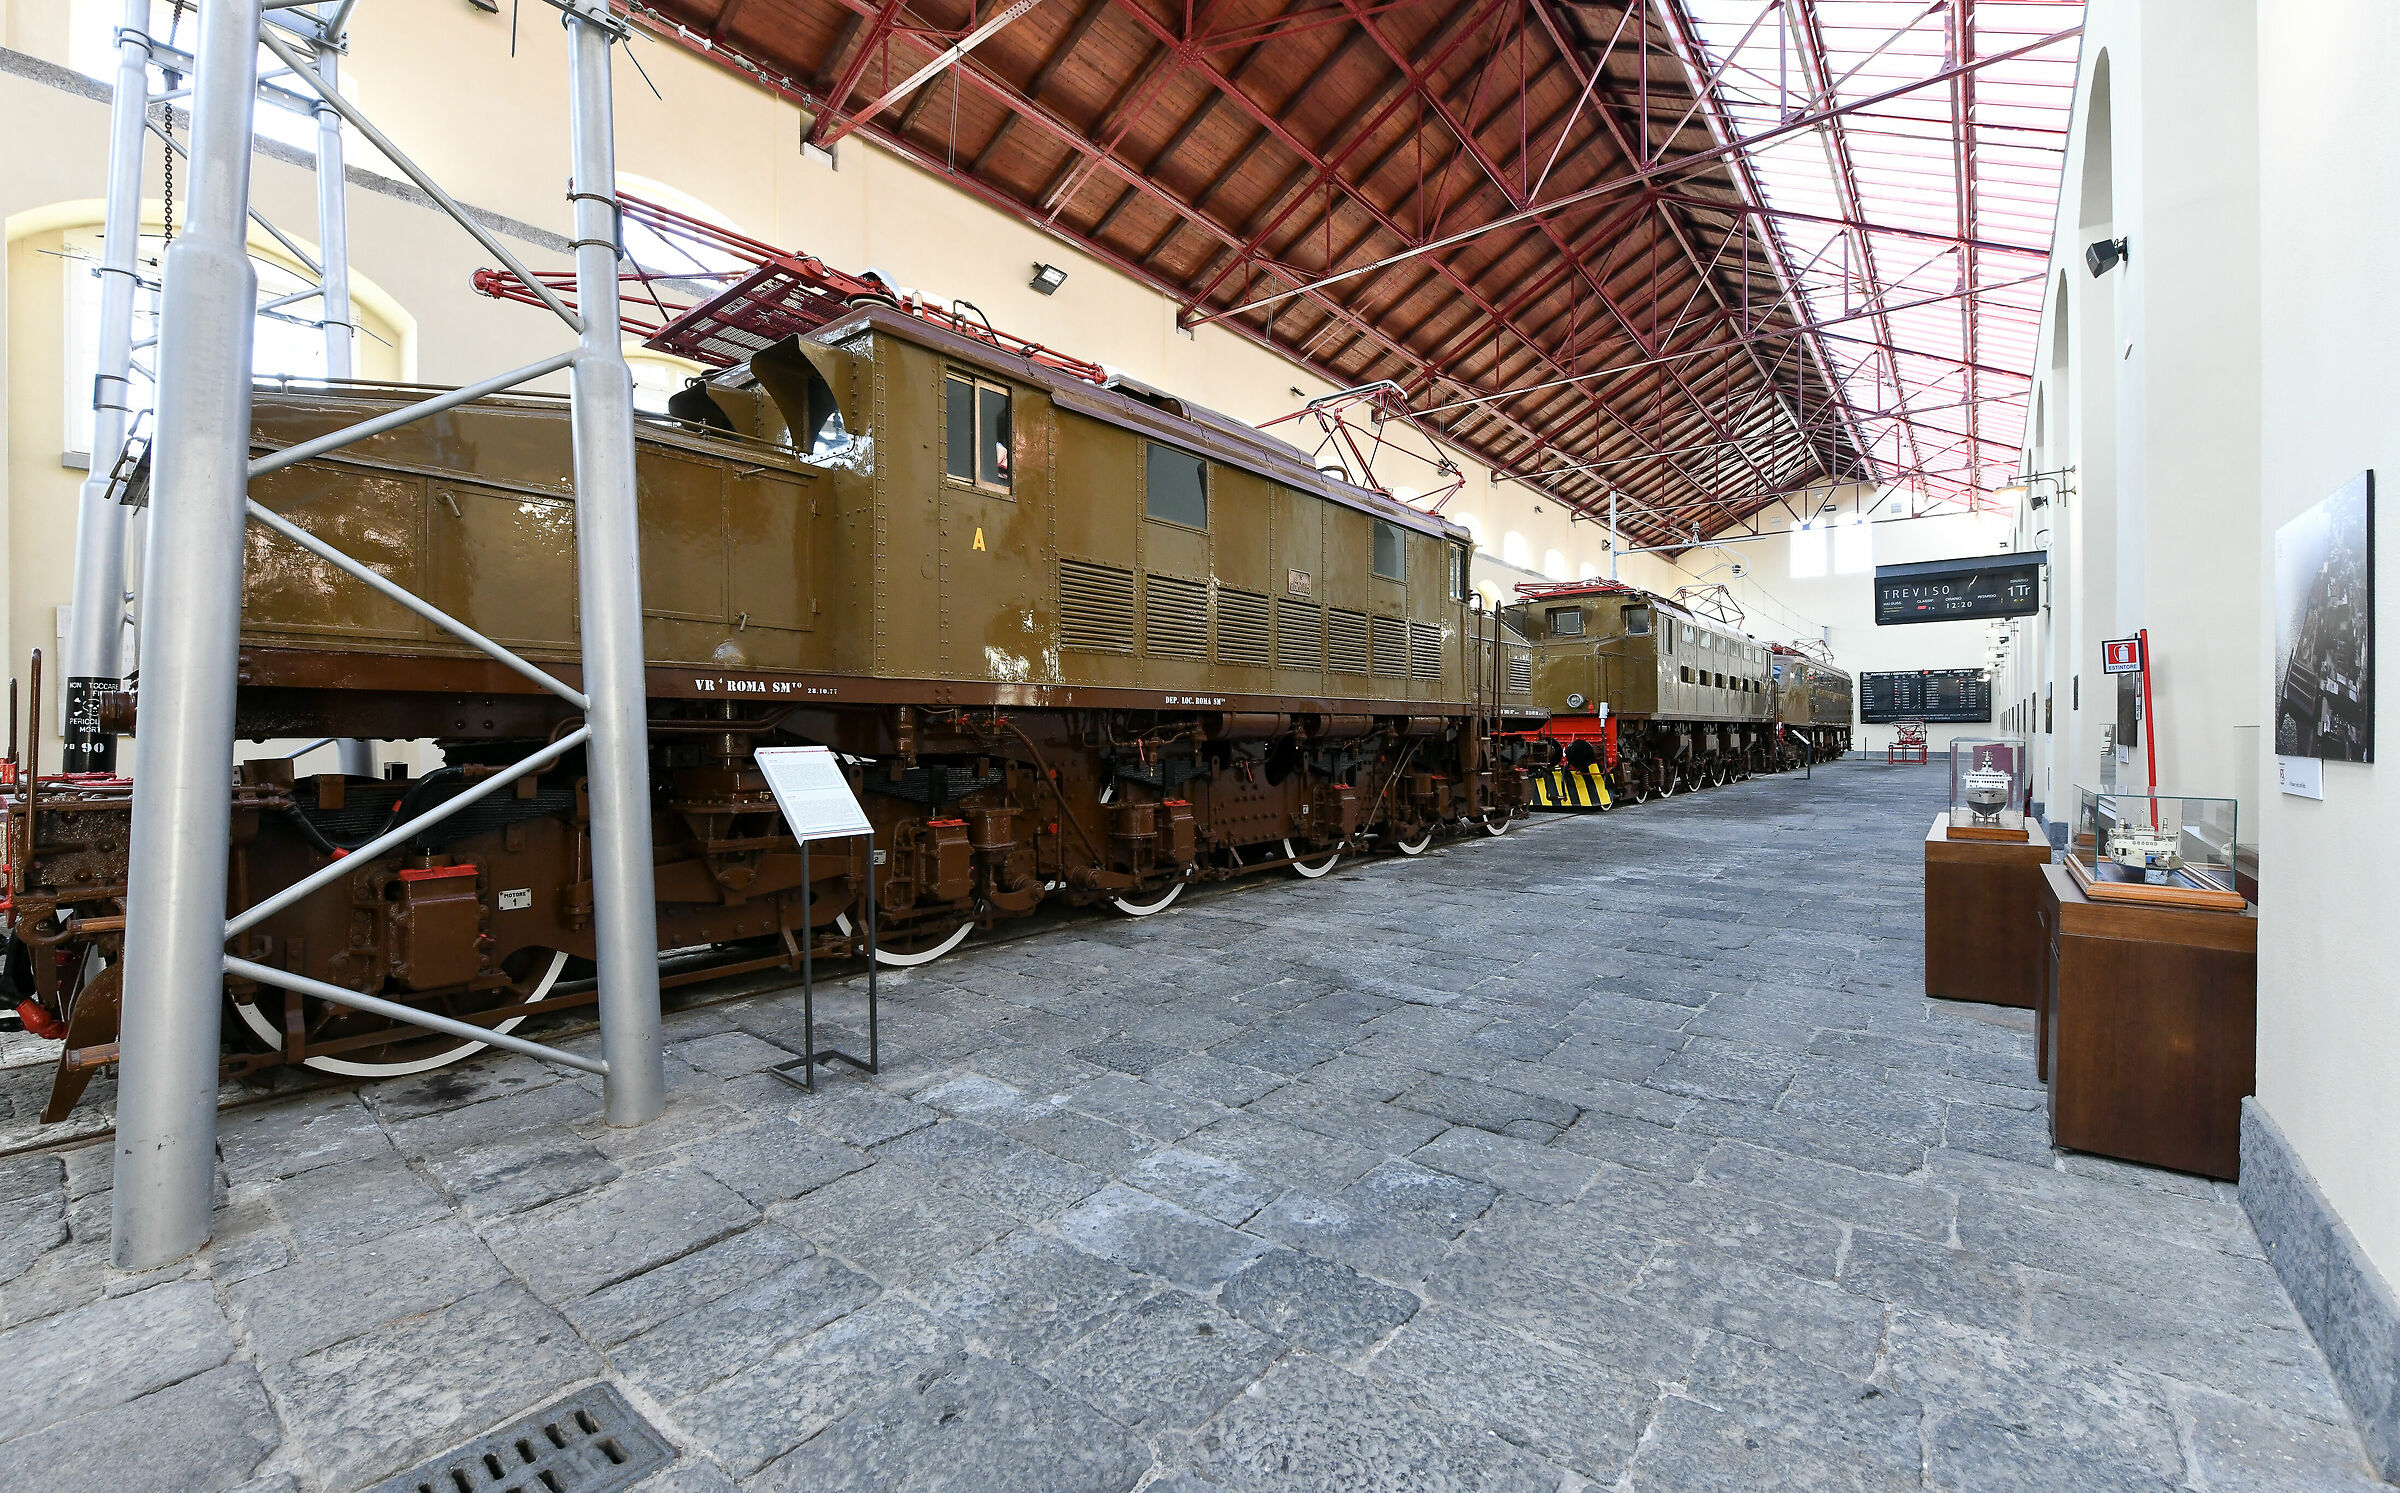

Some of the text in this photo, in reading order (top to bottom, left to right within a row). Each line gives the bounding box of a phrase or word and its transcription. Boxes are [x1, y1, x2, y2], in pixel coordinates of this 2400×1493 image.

[972, 527, 986, 552] A
[1883, 585, 1950, 600] TREVISO
[1945, 601, 1973, 609] 12:20
[88, 682, 119, 690] TOCCARE
[694, 679, 715, 691] VR
[727, 680, 767, 693] ROMA
[1165, 696, 1180, 704] DEP.
[1182, 696, 1194, 704] LOC.
[69, 717, 100, 725] PERICOL
[81, 742, 105, 753] 90
[503, 891, 526, 899] MOTORE
[512, 898, 517, 907] 1
